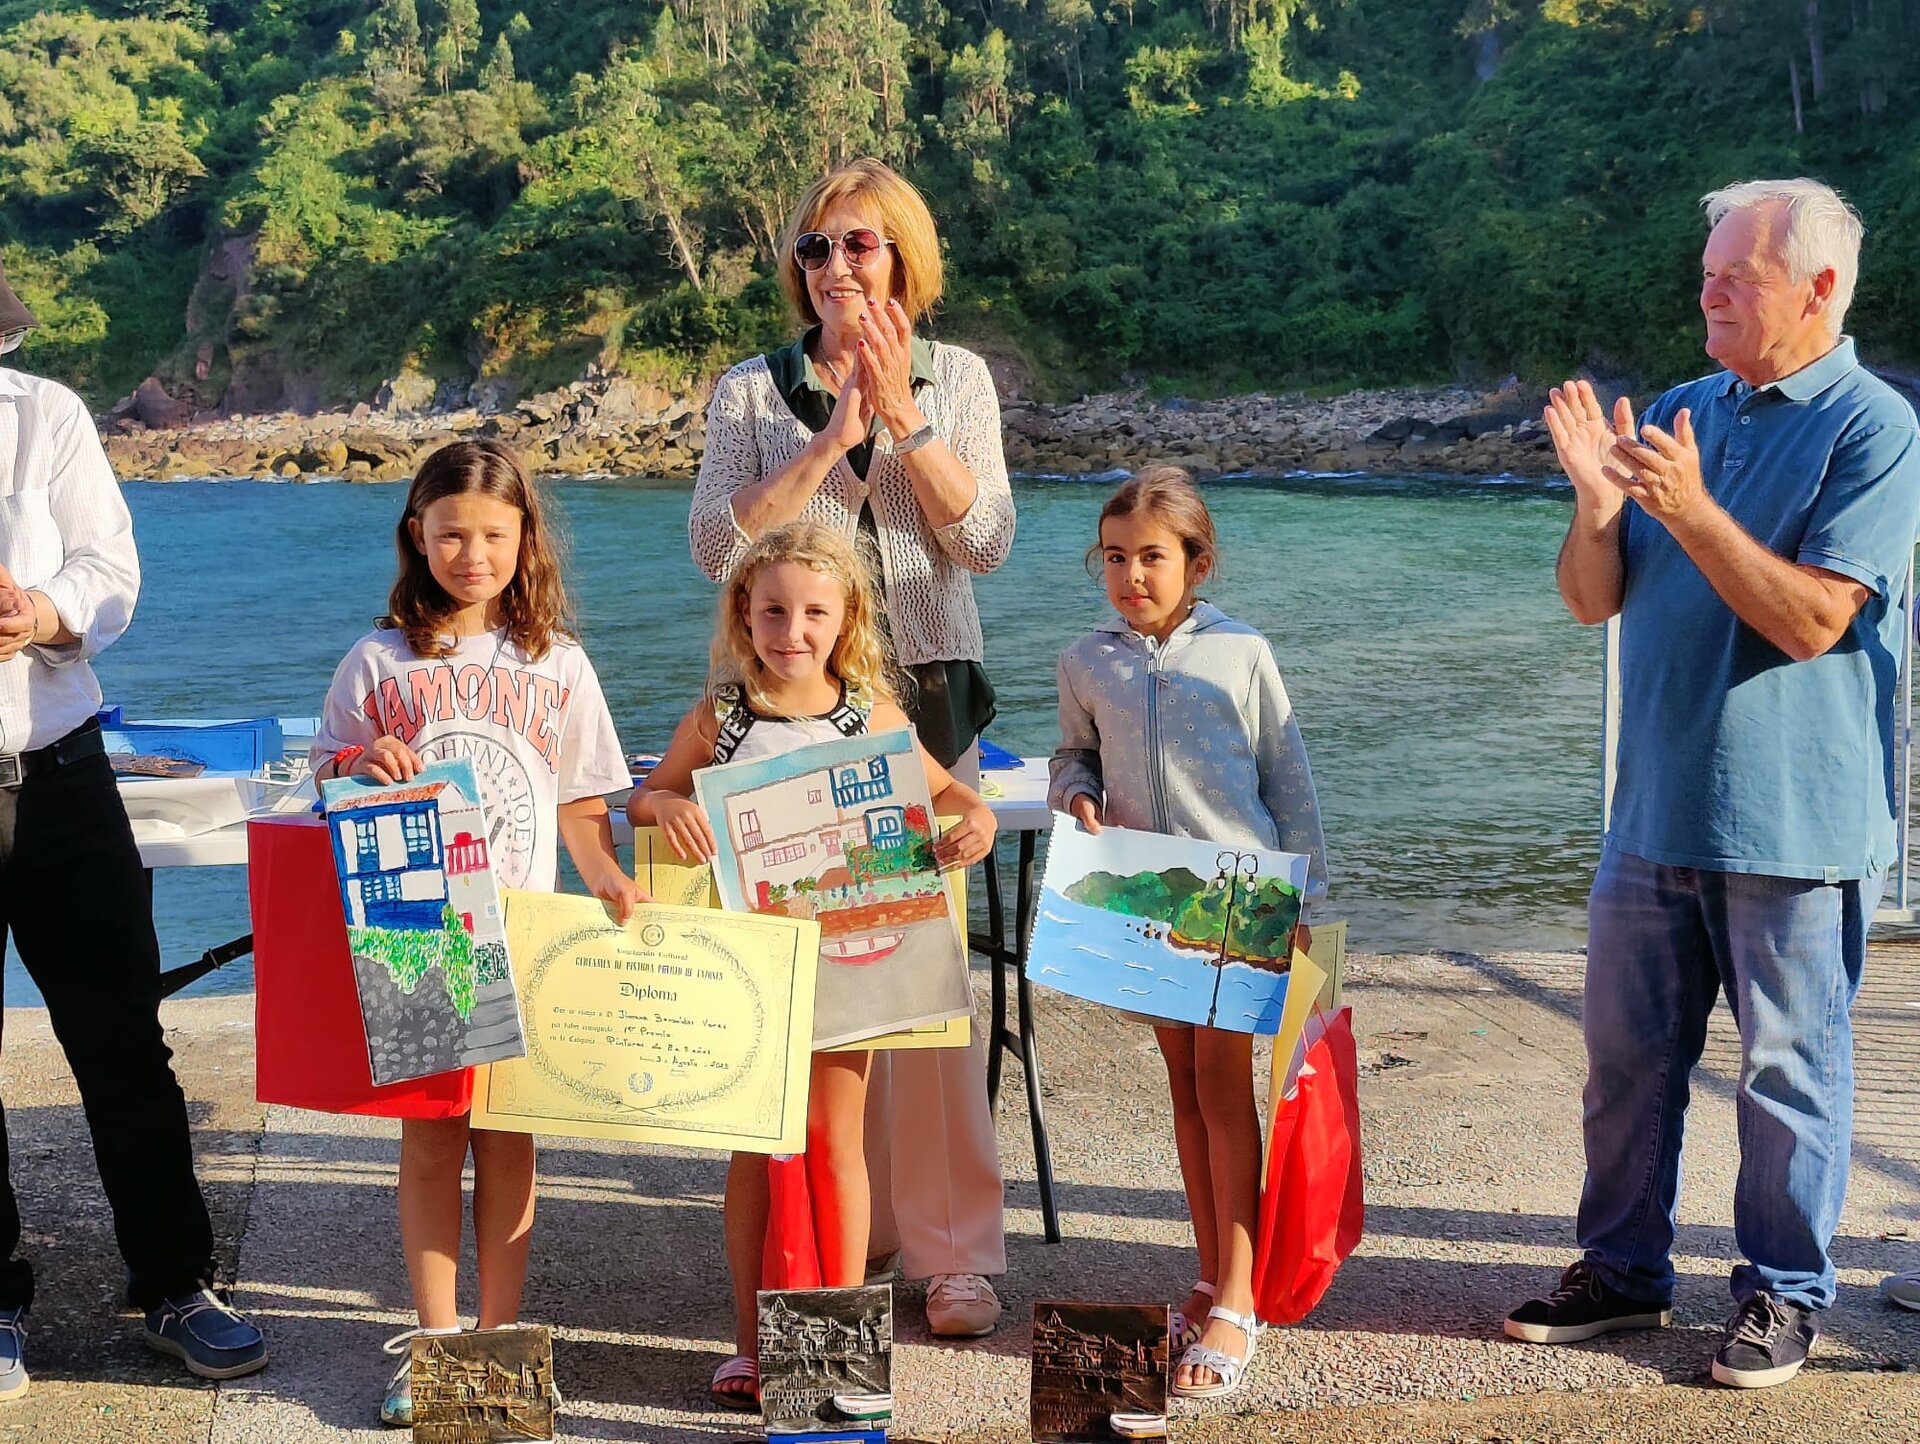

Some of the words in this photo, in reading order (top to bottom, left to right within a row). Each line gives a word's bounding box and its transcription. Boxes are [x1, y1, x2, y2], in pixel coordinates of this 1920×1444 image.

[362, 663, 571, 775] AMONE
[420, 737, 515, 777] OHNNY
[712, 719, 748, 767] OVE
[509, 791, 532, 854] JOEY
[619, 981, 677, 1002] Diploma
[640, 1026, 671, 1038] Premio
[672, 1055, 698, 1068] Agosto
